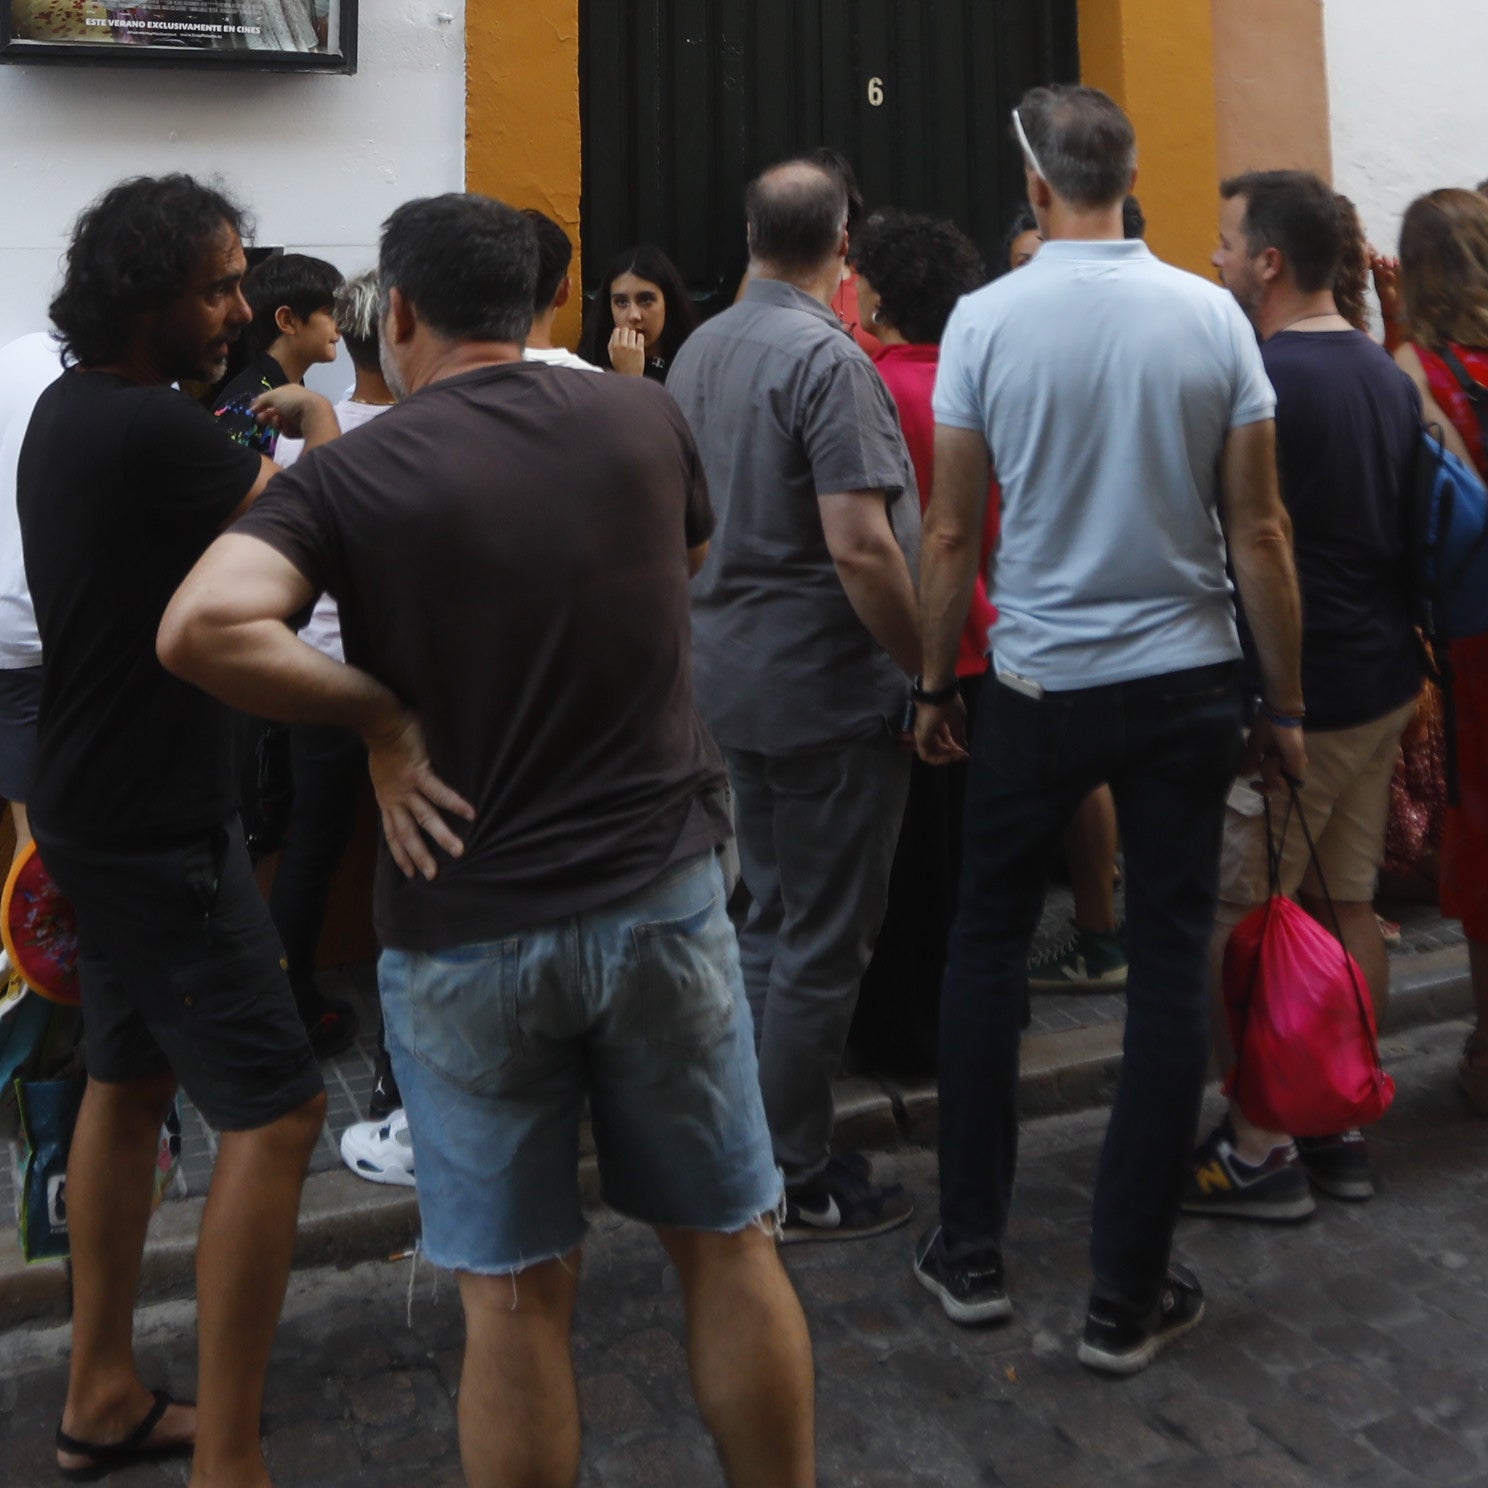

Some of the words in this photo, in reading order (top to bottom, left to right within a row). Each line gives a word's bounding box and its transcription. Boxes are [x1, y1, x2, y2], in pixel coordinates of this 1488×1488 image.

[85, 17, 107, 27] ESTE
[108, 19, 146, 29] VERANO
[147, 21, 222, 33] EXCLUSIVAMENTE
[223, 25, 236, 33] EN
[236, 26, 261, 35] CINES
[867, 76, 884, 107] 6
